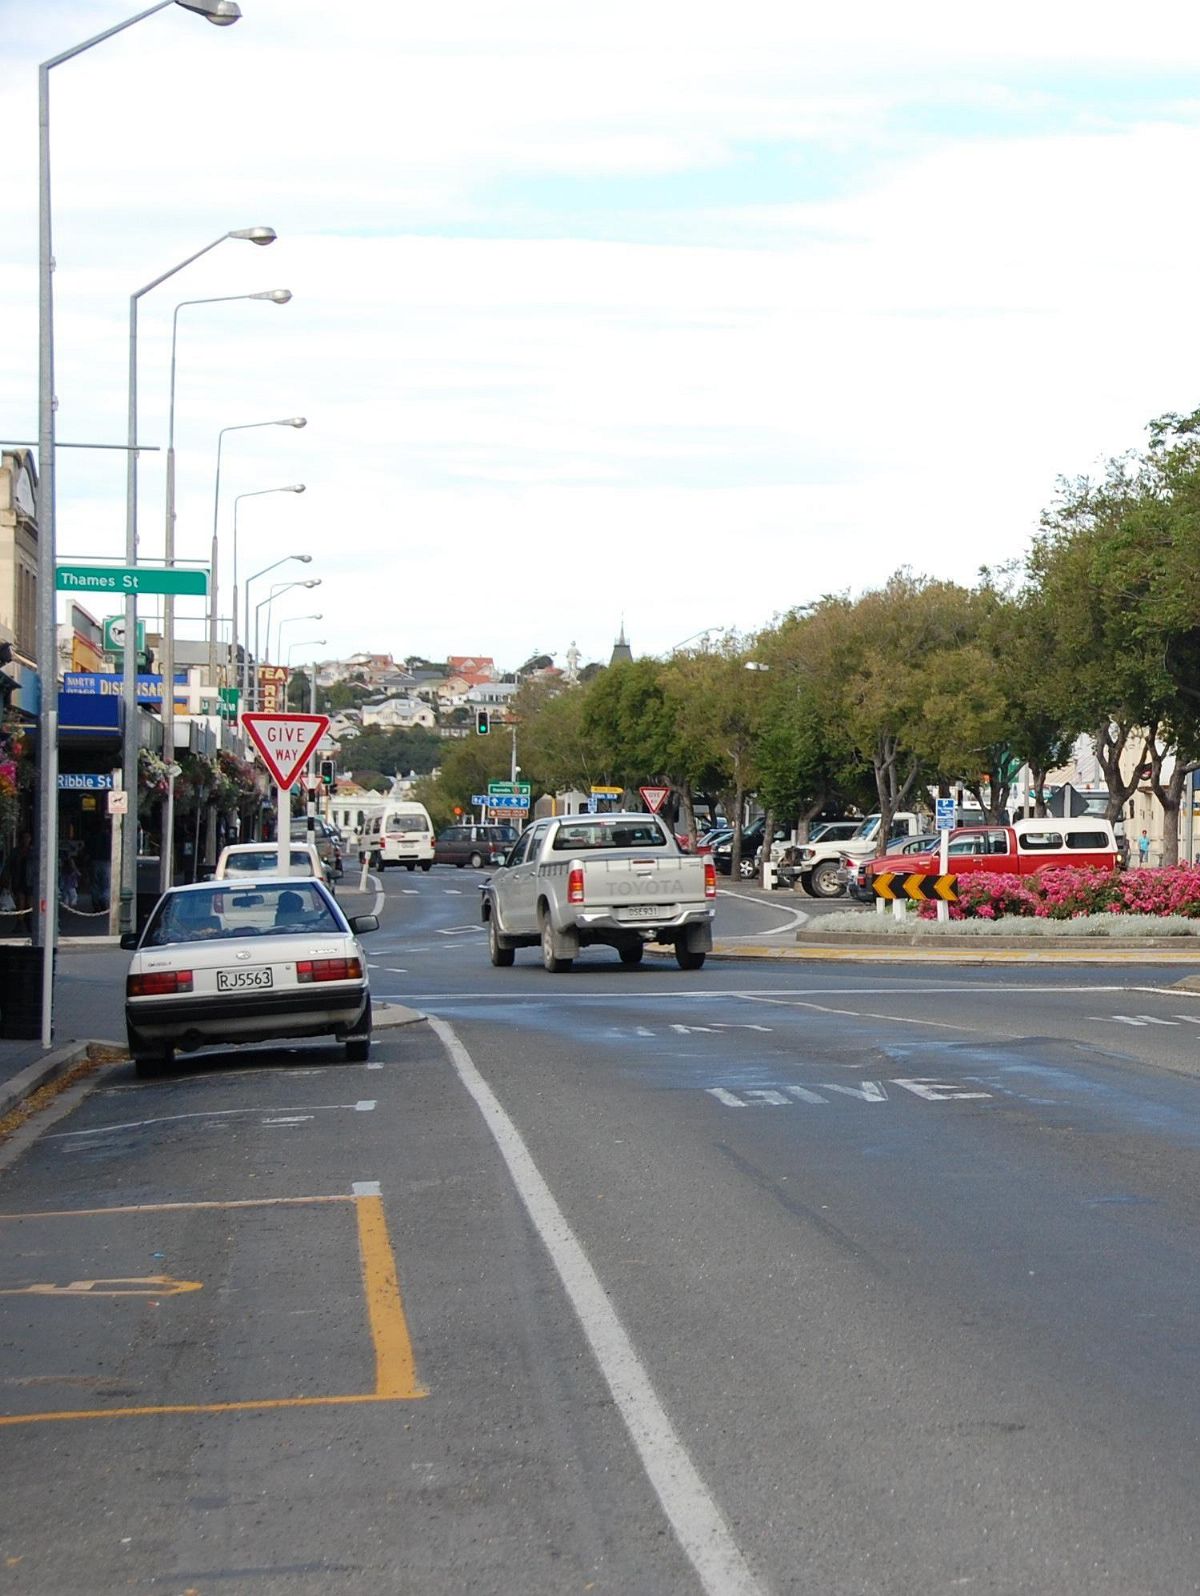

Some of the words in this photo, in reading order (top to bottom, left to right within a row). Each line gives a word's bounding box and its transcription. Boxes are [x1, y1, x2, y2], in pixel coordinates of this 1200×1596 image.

[61, 572, 116, 587] Thames
[122, 575, 139, 588] St
[258, 667, 286, 679] TEA
[267, 727, 305, 742] GIVE
[275, 749, 298, 760] WAY
[58, 775, 94, 787] Ribble
[97, 775, 112, 788] St
[606, 880, 685, 896] TOYOTA
[220, 971, 270, 988] RJ5563
[705, 1078, 993, 1107] GIVE
